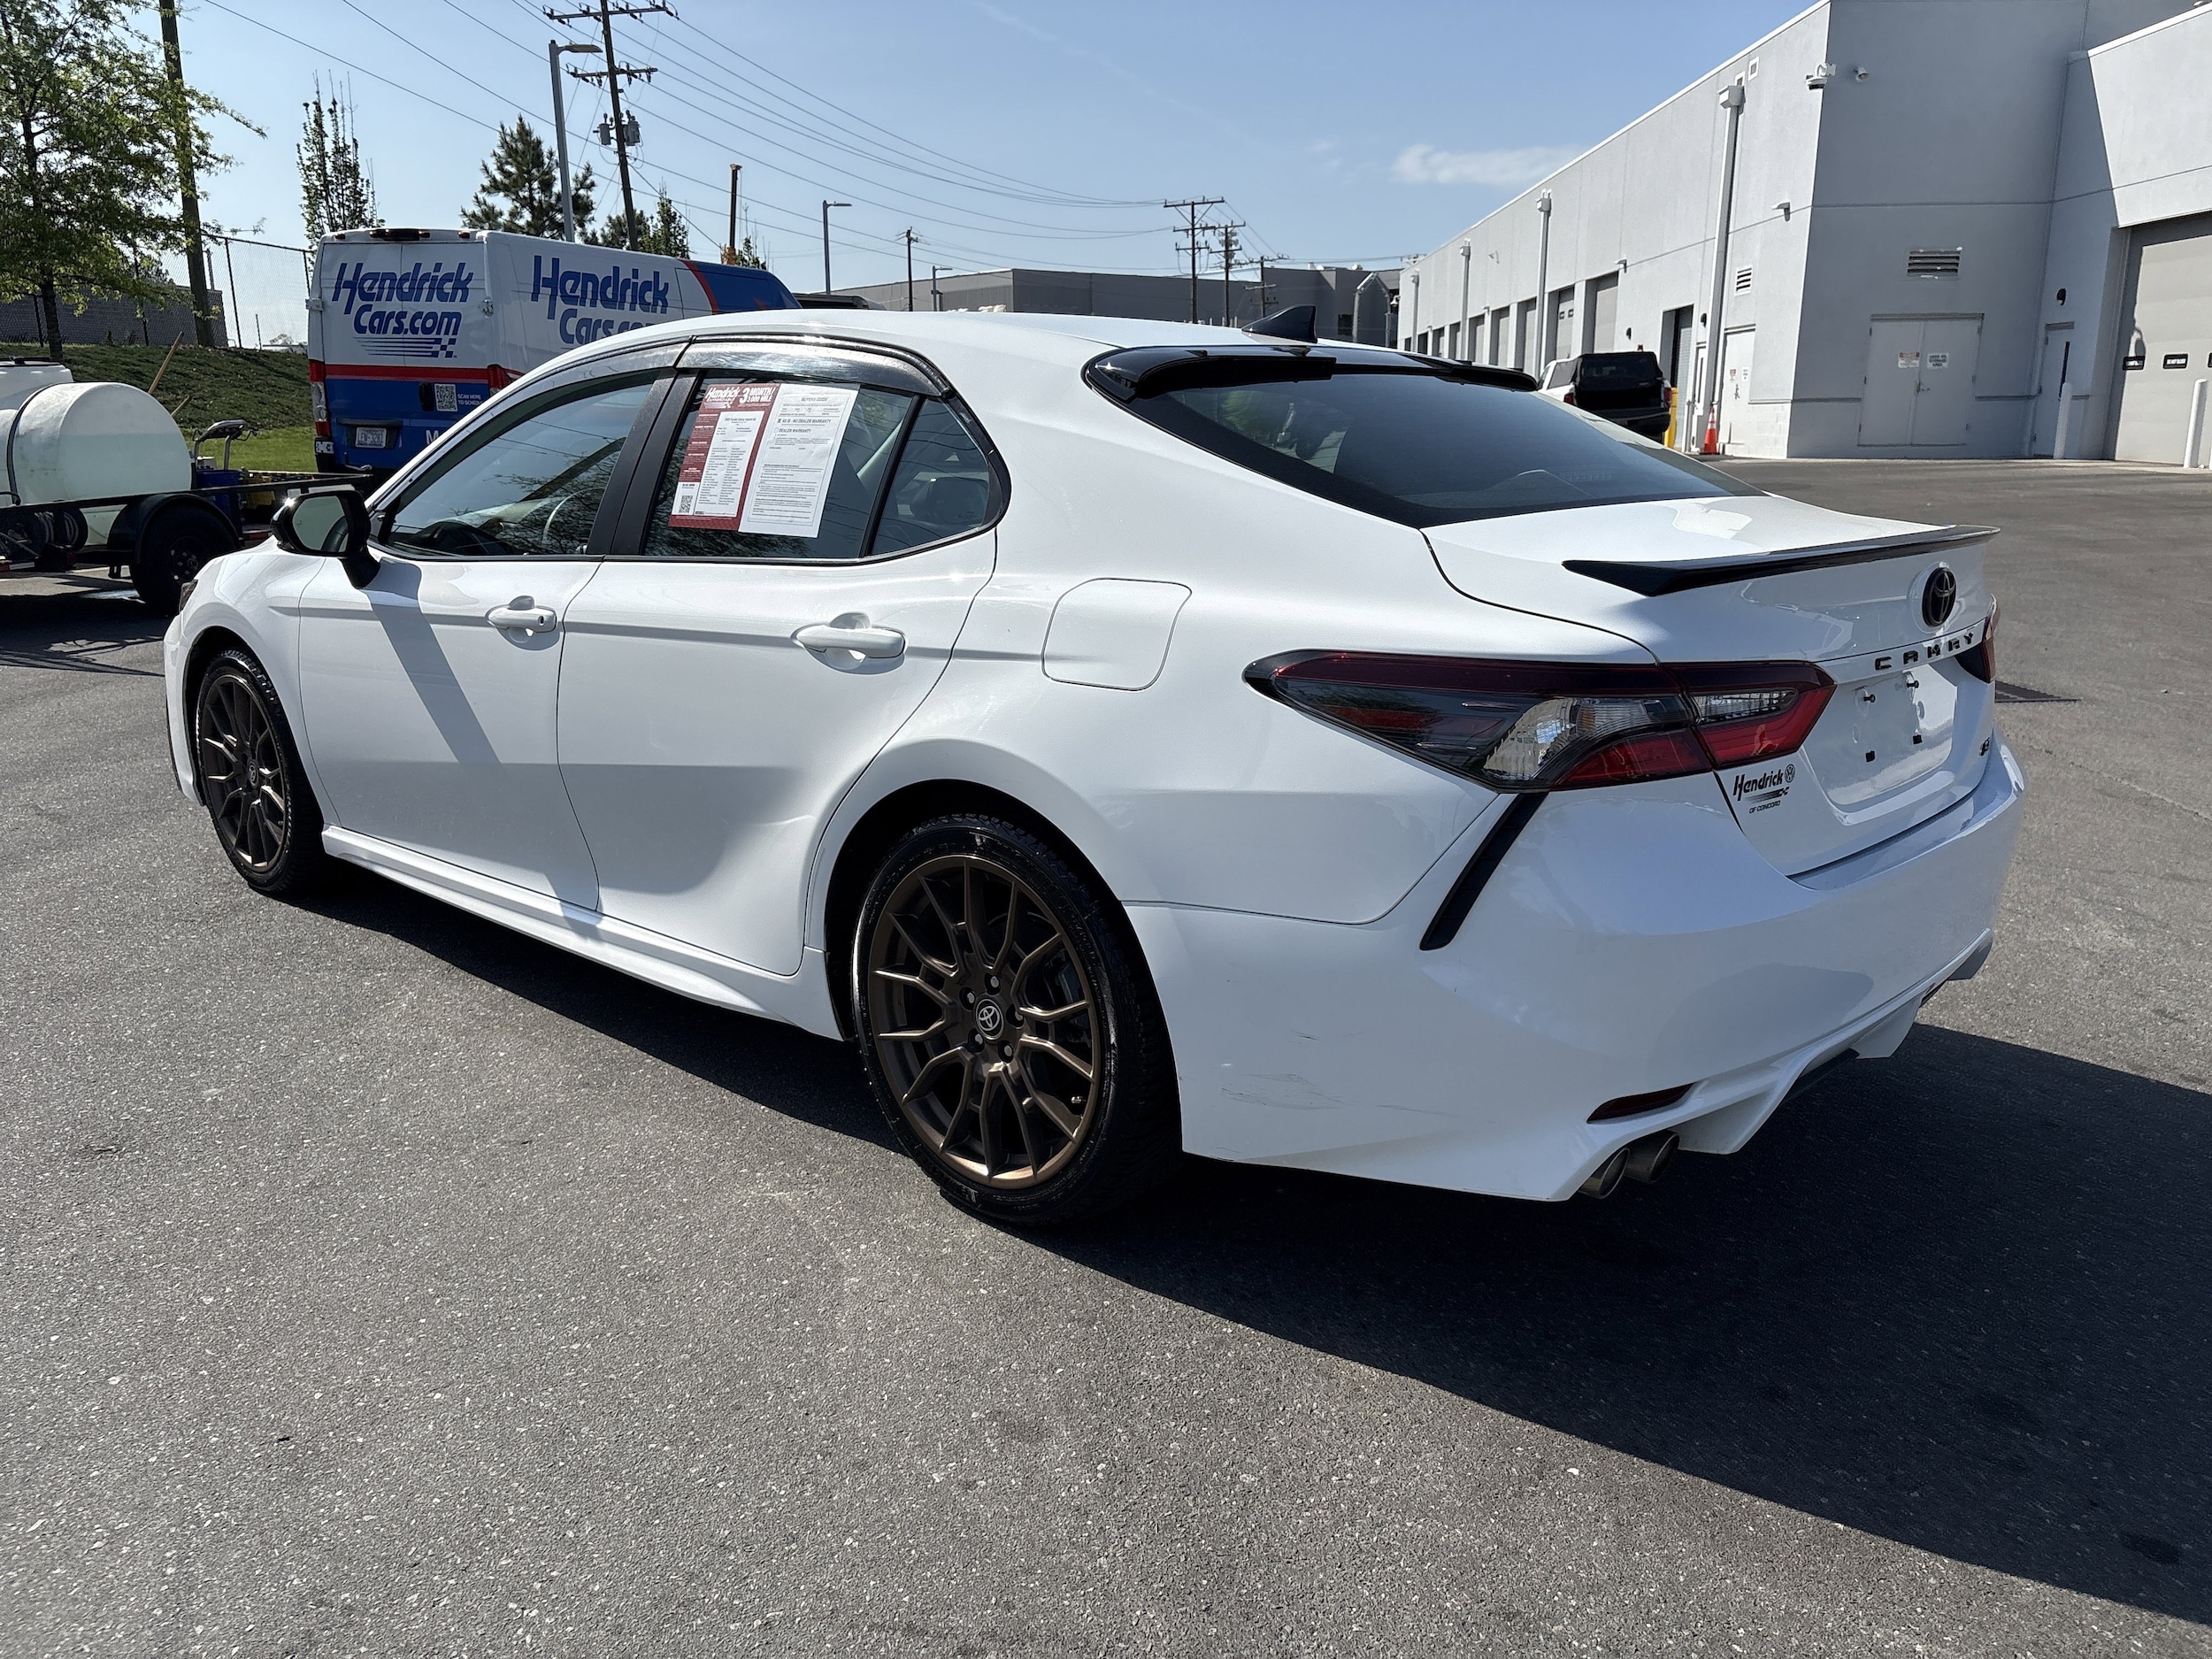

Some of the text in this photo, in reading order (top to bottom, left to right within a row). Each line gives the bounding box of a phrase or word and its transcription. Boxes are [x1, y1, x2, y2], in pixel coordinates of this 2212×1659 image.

[332, 262, 474, 315] Hendrick
[531, 255, 669, 320] Hendrick
[353, 303, 462, 336] Cars.com
[739, 387, 750, 403] 3
[1875, 632, 1974, 671] CAMRY
[1732, 769, 1784, 802] Hendrick
[1756, 800, 1781, 812] CONCORD
